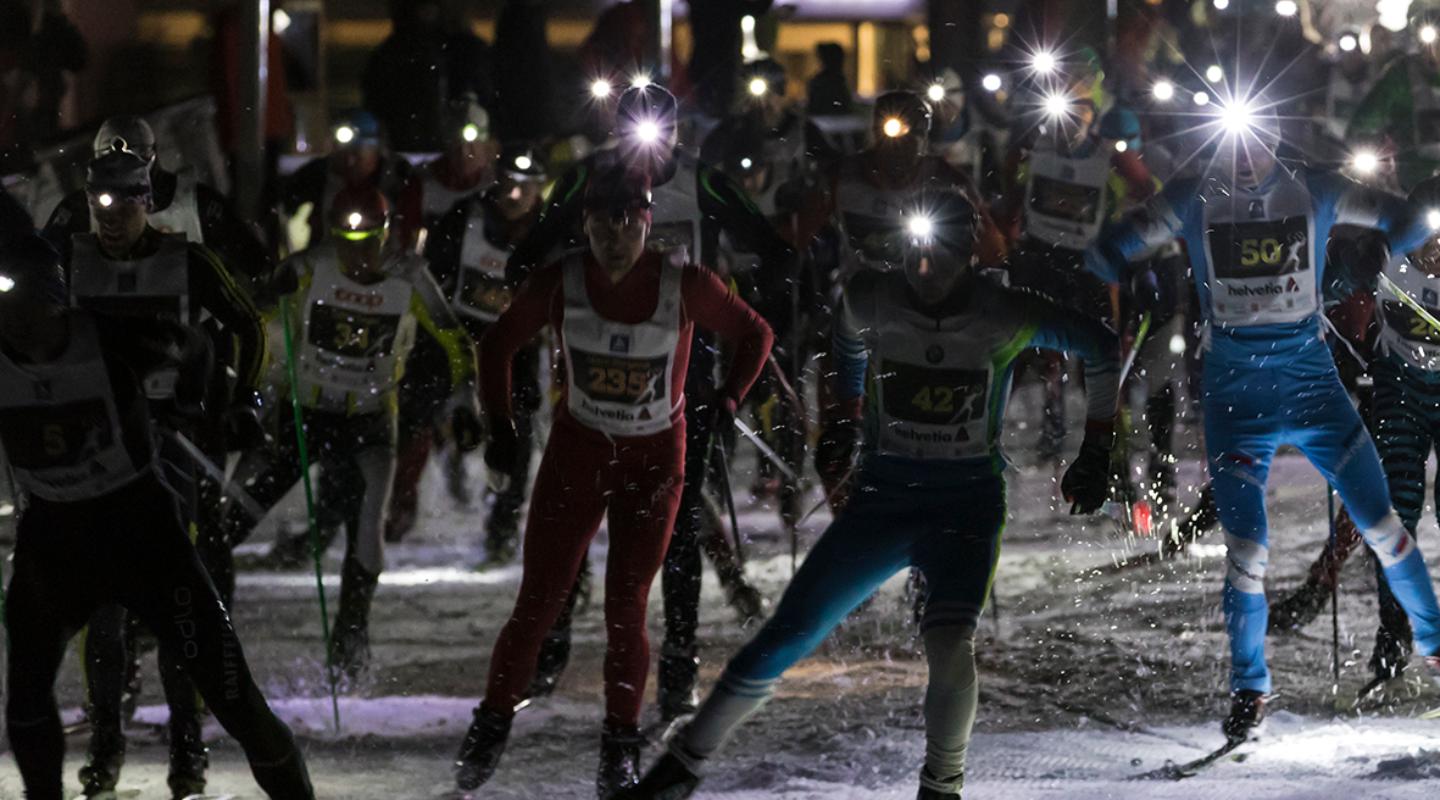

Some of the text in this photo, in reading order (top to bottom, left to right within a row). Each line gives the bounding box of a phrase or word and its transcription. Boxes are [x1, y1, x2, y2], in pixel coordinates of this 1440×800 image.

[1241, 239, 1282, 266] 50
[1228, 283, 1283, 297] helvetia
[912, 385, 954, 413] 42
